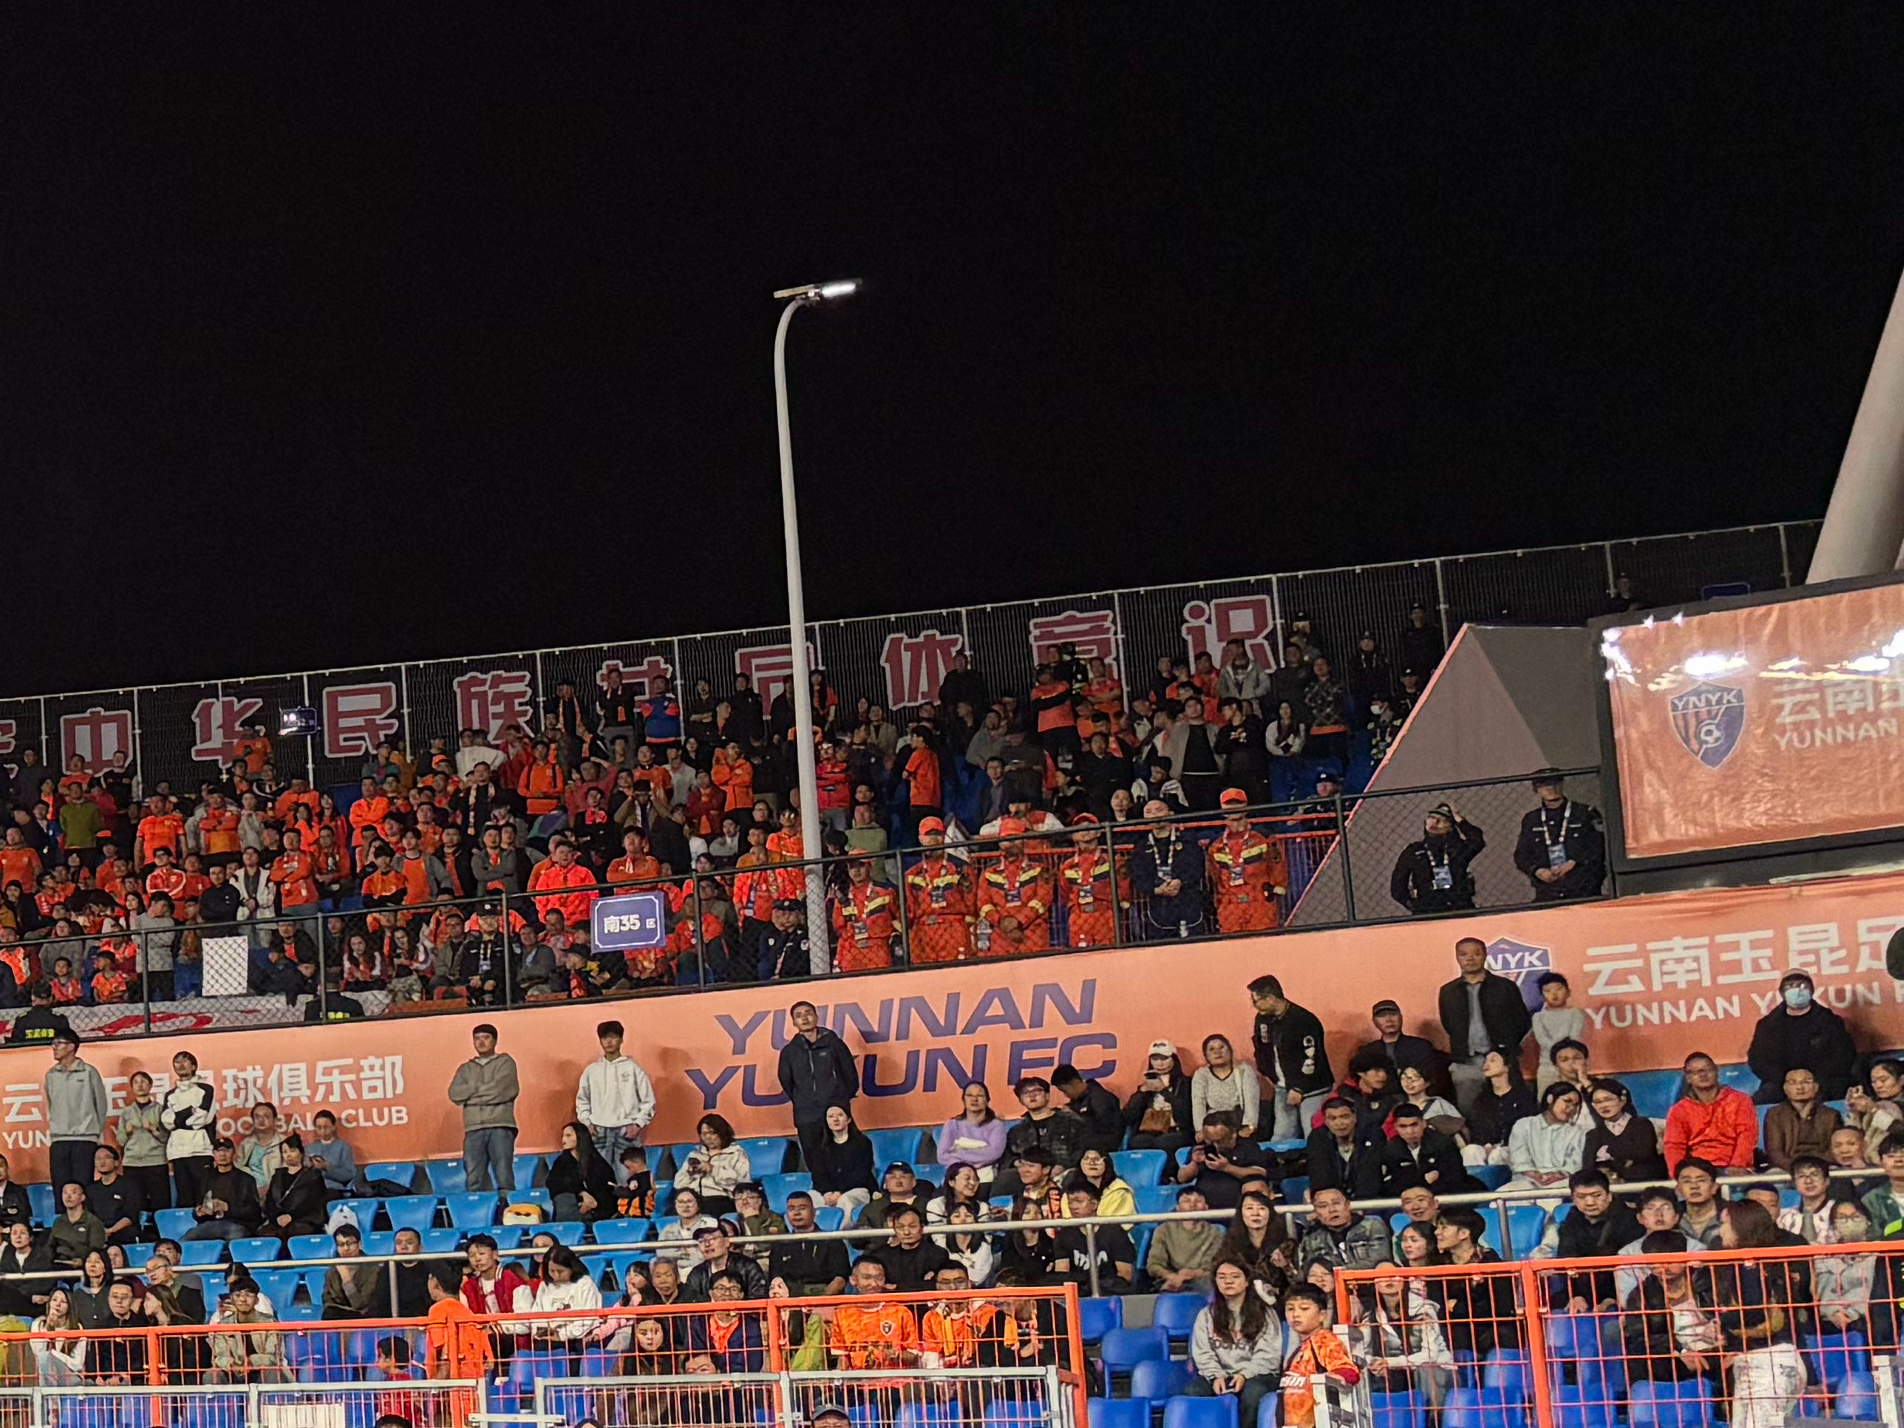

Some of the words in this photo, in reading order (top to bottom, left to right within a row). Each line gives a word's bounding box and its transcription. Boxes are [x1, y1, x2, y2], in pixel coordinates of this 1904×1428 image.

[1670, 689, 1739, 712] YNYK
[1774, 676, 1904, 725] 云南
[1774, 717, 1897, 751] YUNNAN
[1486, 949, 1545, 970] NYK
[1588, 994, 1742, 1030] YUNNAN
[1752, 980, 1881, 1015] YKUN
[685, 1043, 988, 1111] YUUN
[1007, 1032, 1118, 1087] FC
[341, 1106, 409, 1128] CLUB
